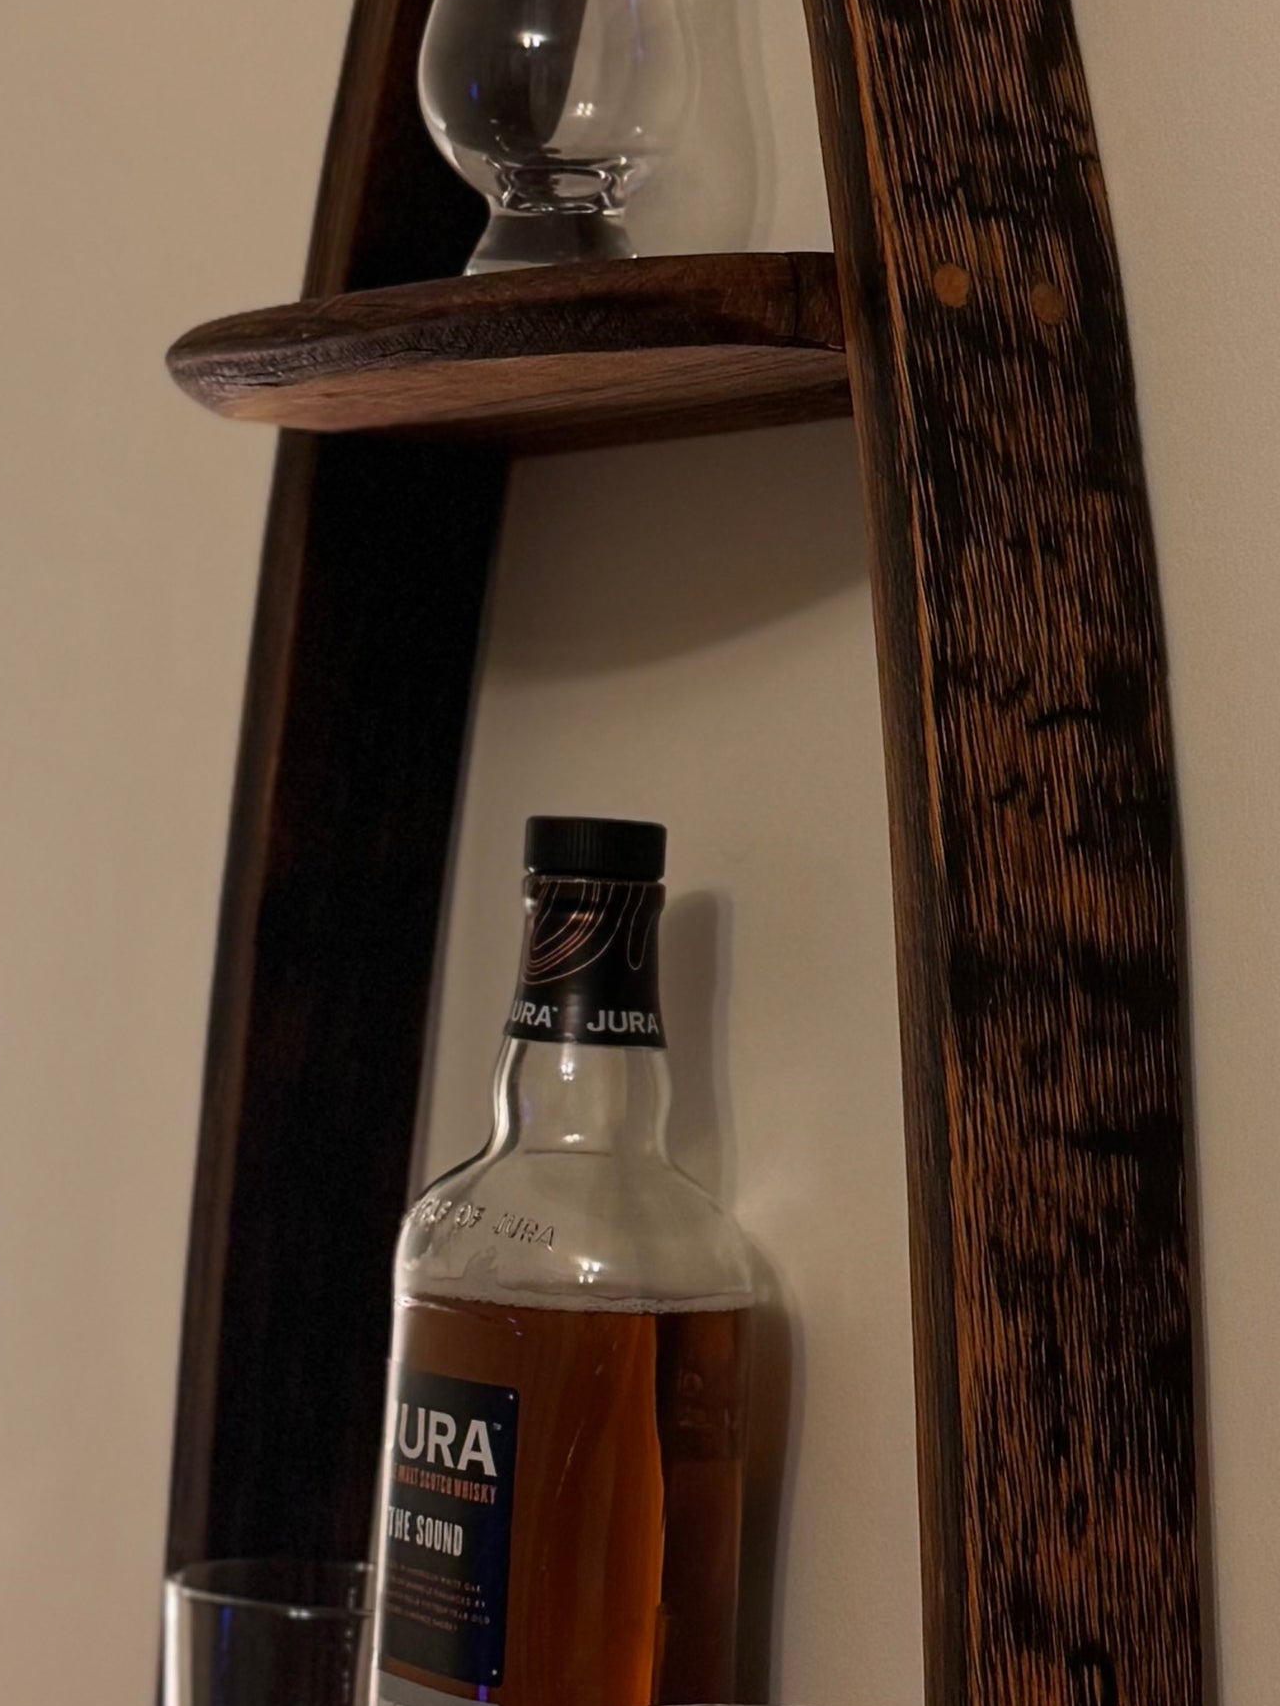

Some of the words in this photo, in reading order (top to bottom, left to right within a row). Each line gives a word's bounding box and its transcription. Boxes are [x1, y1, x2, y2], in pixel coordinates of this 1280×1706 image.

[511, 1001, 552, 1029] URA
[586, 1009, 660, 1035] JURA
[493, 1213, 554, 1252] JURA
[398, 1403, 498, 1477] URA
[453, 1478, 498, 1506] WHISKY
[416, 1514, 463, 1557] SOUND
